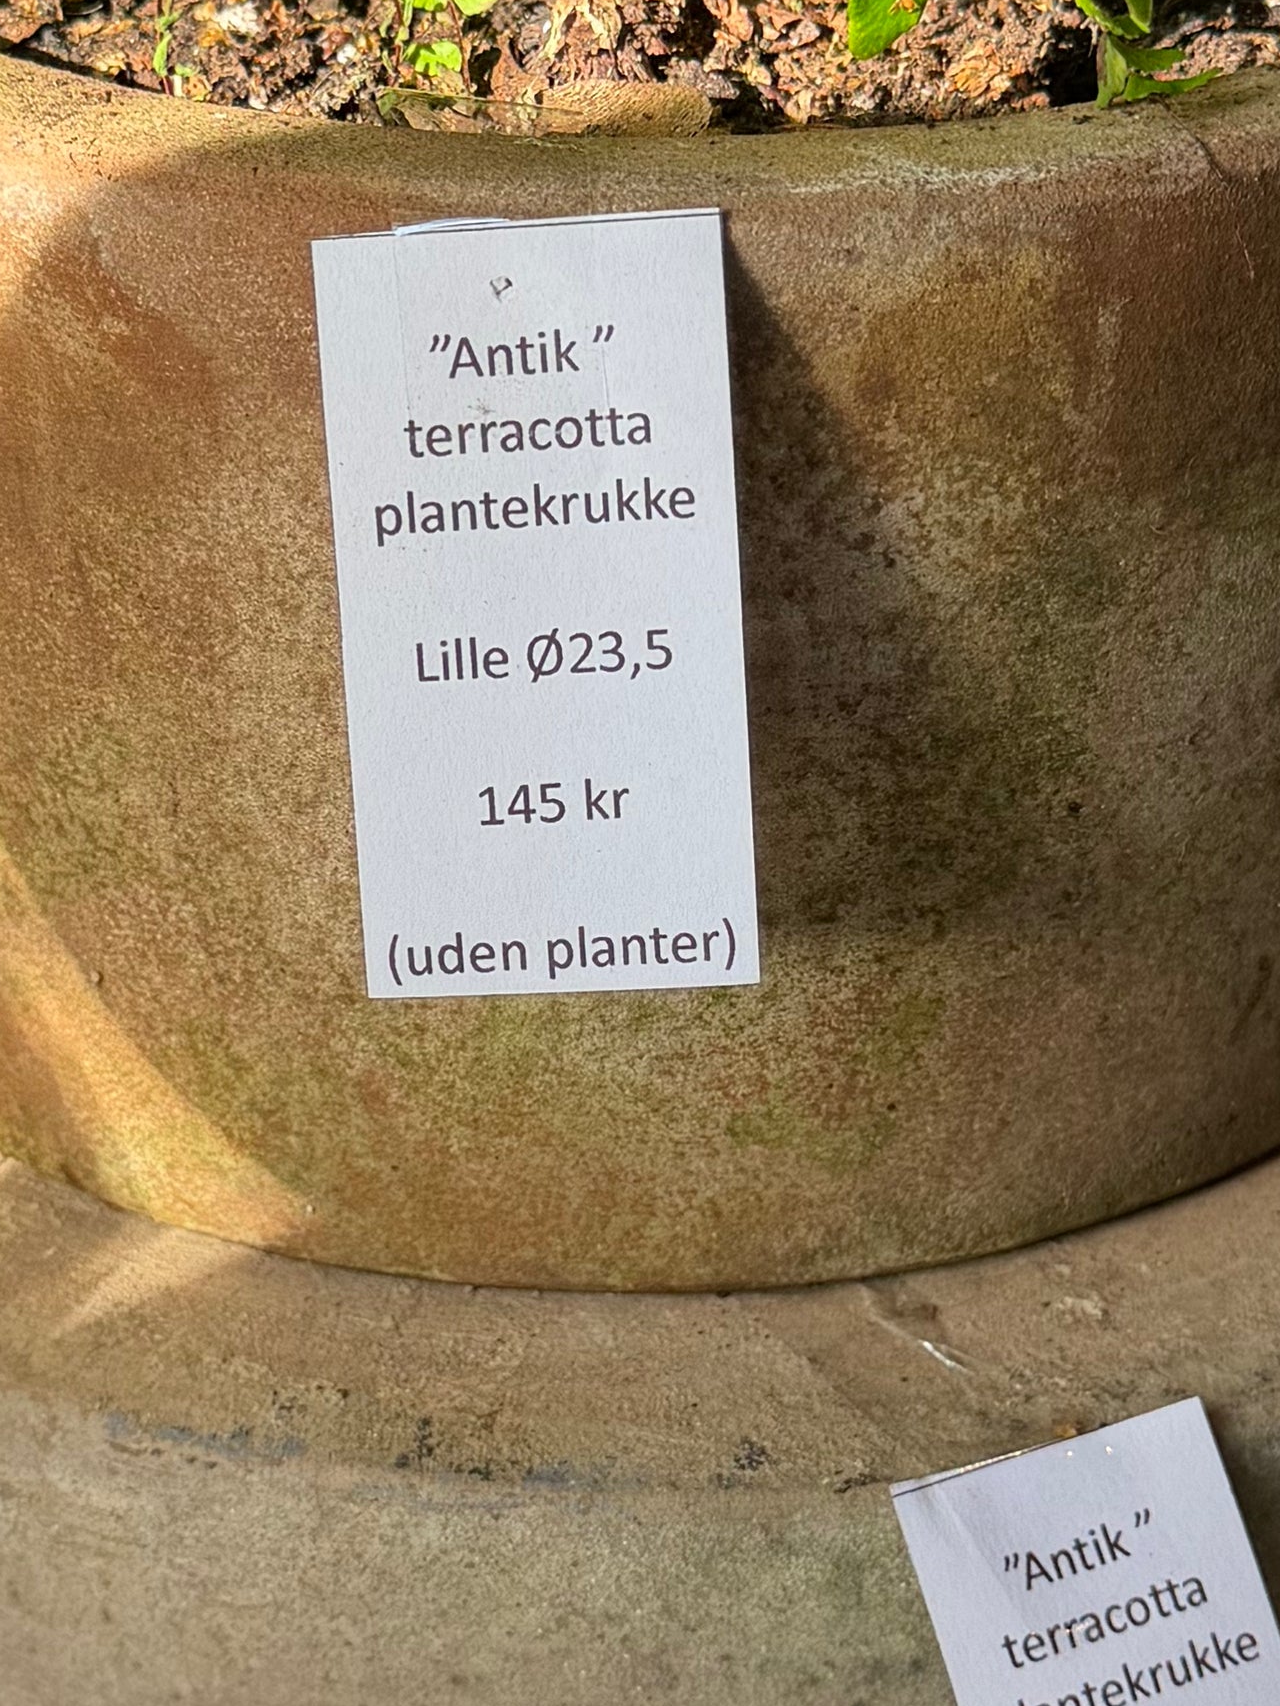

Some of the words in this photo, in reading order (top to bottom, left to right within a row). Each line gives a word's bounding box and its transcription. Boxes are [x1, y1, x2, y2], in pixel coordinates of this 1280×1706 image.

[402, 406, 652, 459] terracotta
[374, 476, 696, 548] plantekrukke
[415, 636, 510, 683] Lille
[526, 627, 673, 684] Ø23,5
[478, 782, 567, 827] 145
[584, 777, 630, 821] kr
[388, 931, 528, 987] (uden
[546, 917, 737, 981] planter)
[1002, 1571, 1208, 1670] terracotta
